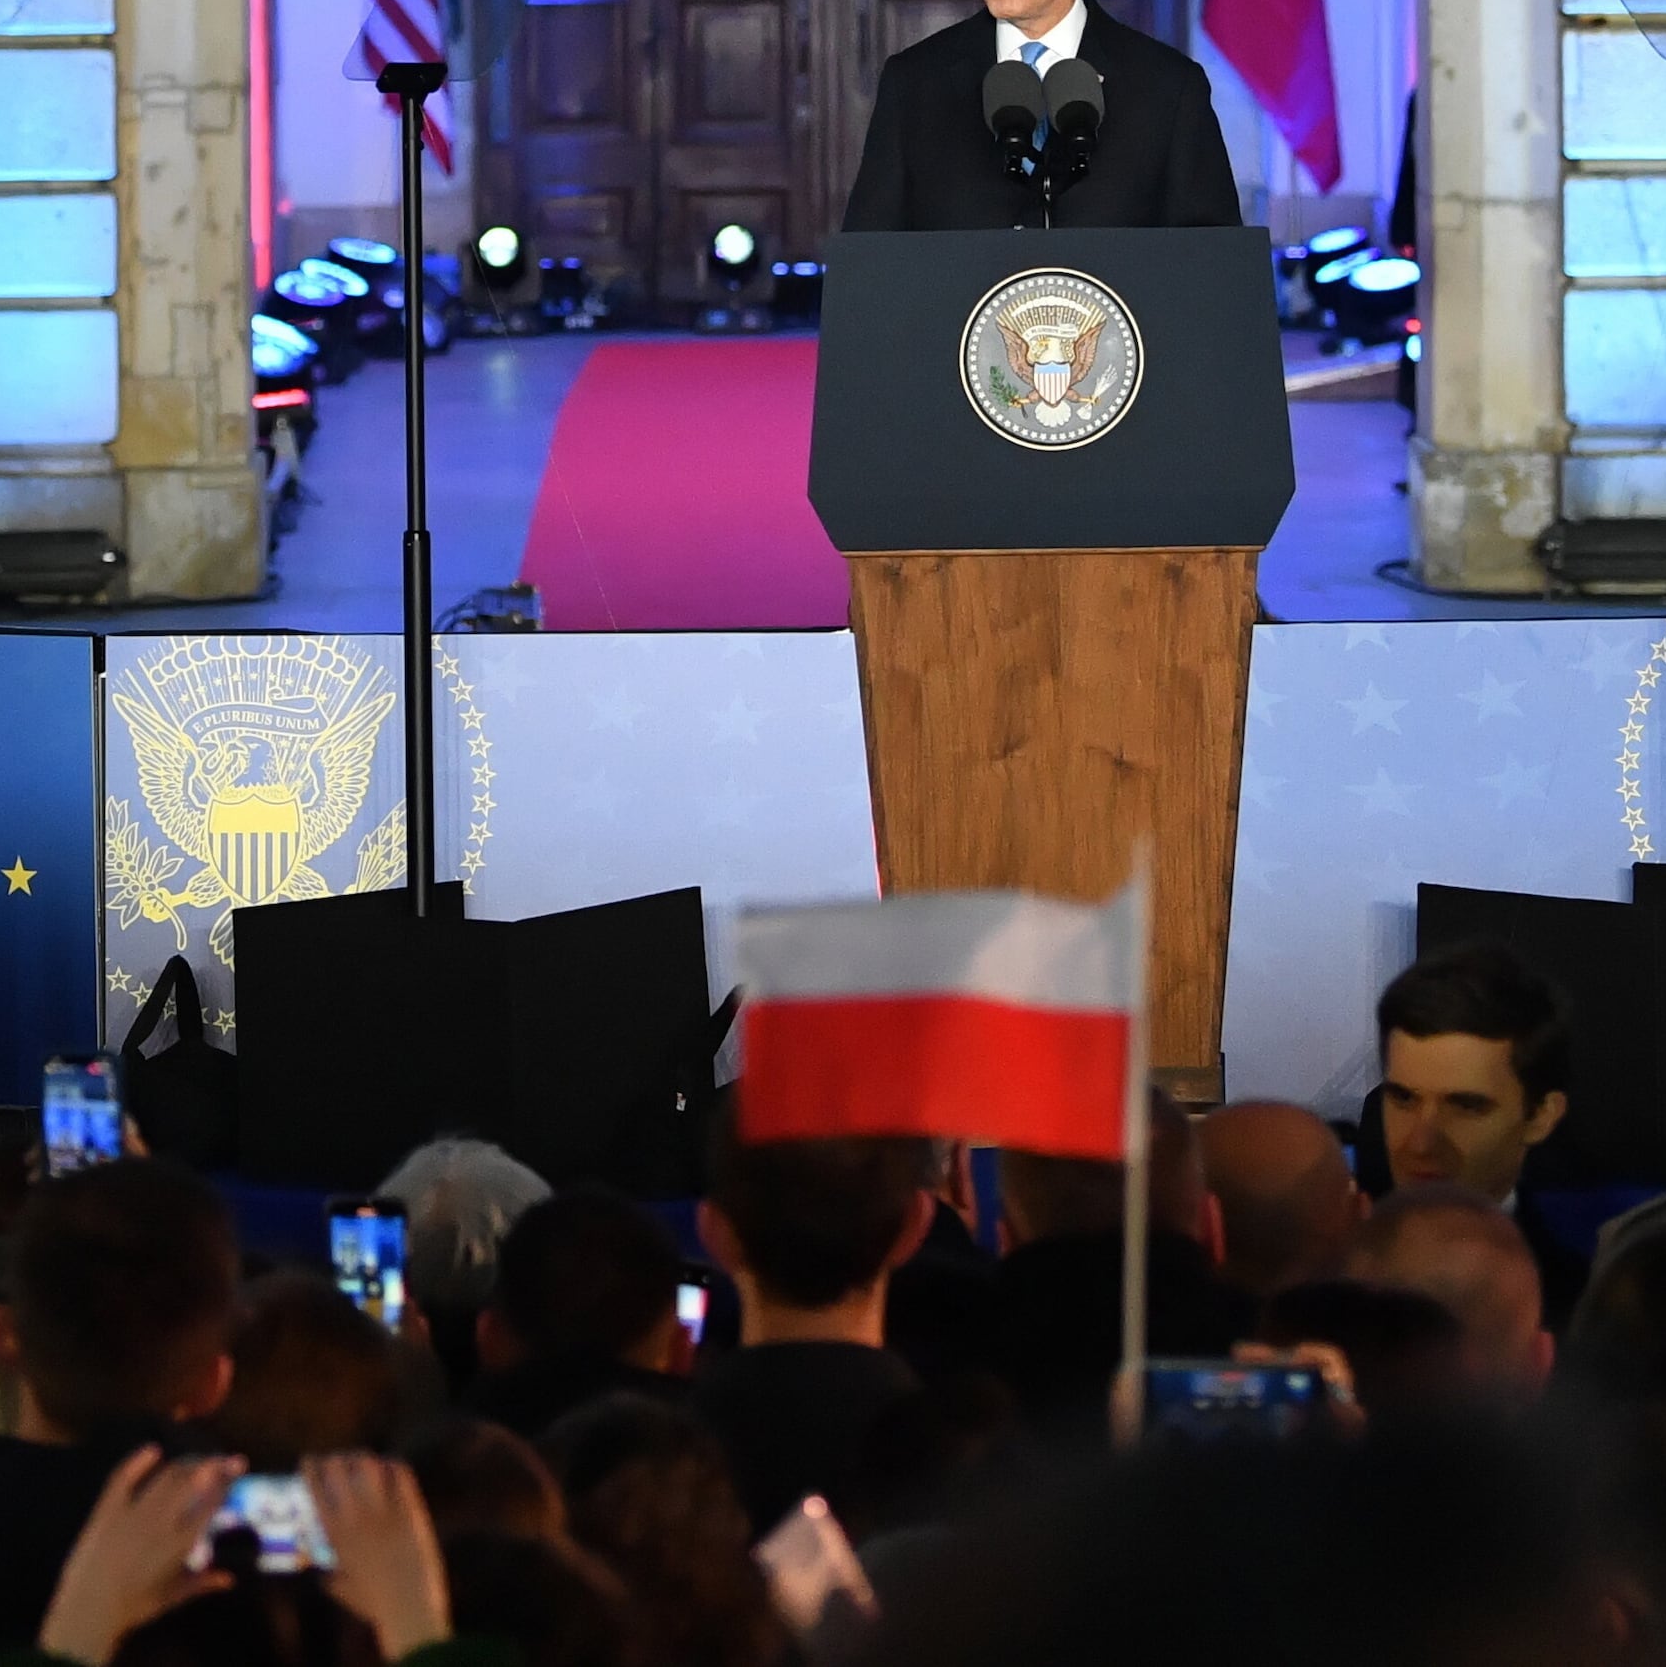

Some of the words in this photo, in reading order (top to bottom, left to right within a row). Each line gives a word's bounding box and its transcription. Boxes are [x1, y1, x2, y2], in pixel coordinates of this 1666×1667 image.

[193, 721, 204, 734] E
[203, 710, 273, 728] PLURIBUS
[276, 716, 320, 730] UNUM
